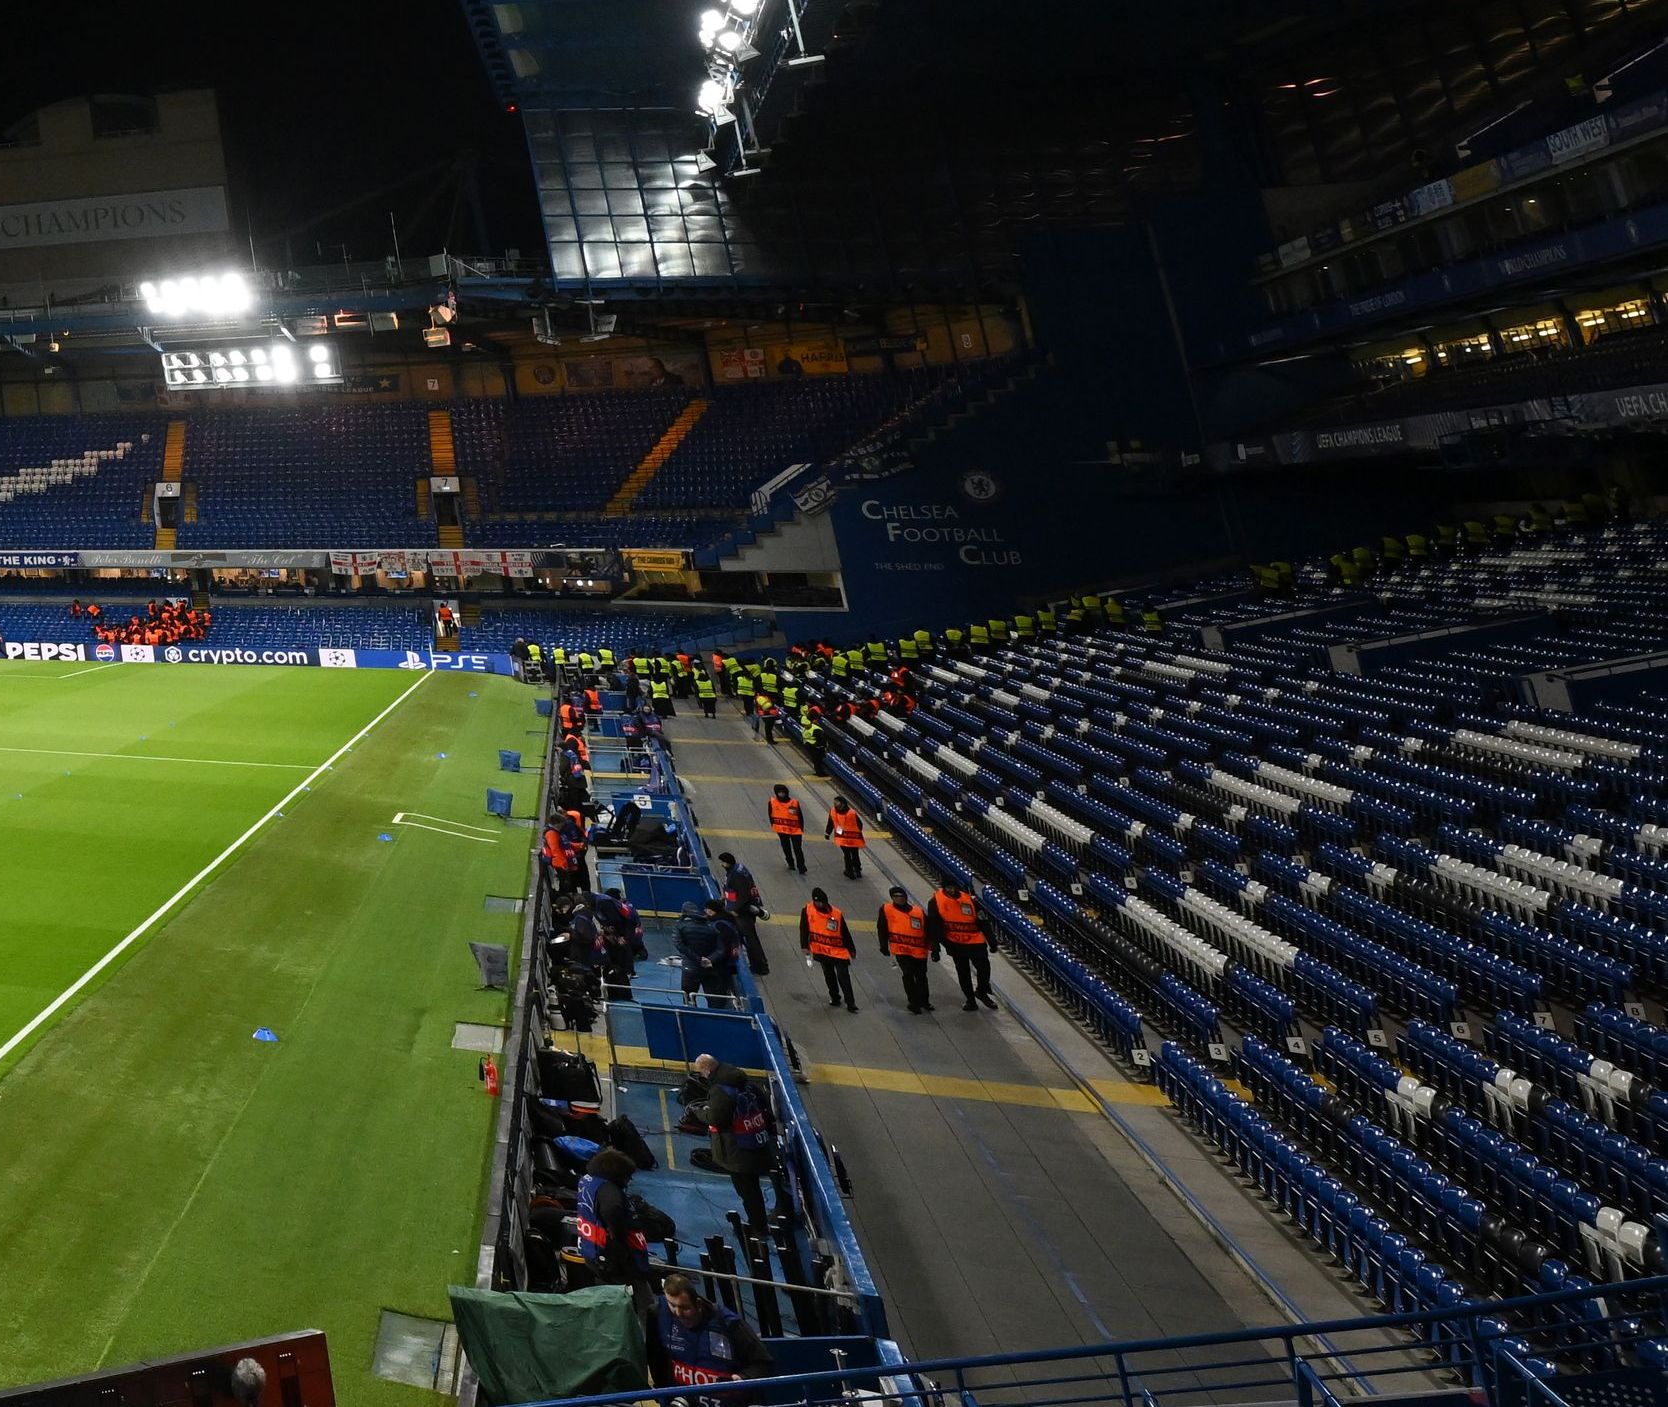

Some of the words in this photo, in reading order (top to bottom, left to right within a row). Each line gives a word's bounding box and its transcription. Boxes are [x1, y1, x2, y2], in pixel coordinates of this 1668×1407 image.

[1581, 117, 1607, 141] WEST
[0, 200, 187, 238] CHAMPIONS
[861, 499, 960, 520] CHELSEA
[886, 522, 1005, 543] FOOTBALL
[24, 555, 56, 565] KING
[959, 544, 1023, 566] CLUB
[5, 642, 86, 661] PEPSI
[188, 648, 308, 665] crypto.com
[432, 654, 488, 670] PS5
[638, 796, 647, 807] 5
[1539, 1015, 1548, 1026] 7
[1456, 1024, 1464, 1035] 6
[1292, 1040, 1301, 1051] 4
[1373, 1033, 1382, 1043] 5
[1137, 1052, 1145, 1061] 2
[1213, 1046, 1222, 1056] 3
[674, 1364, 720, 1385] PHOT
